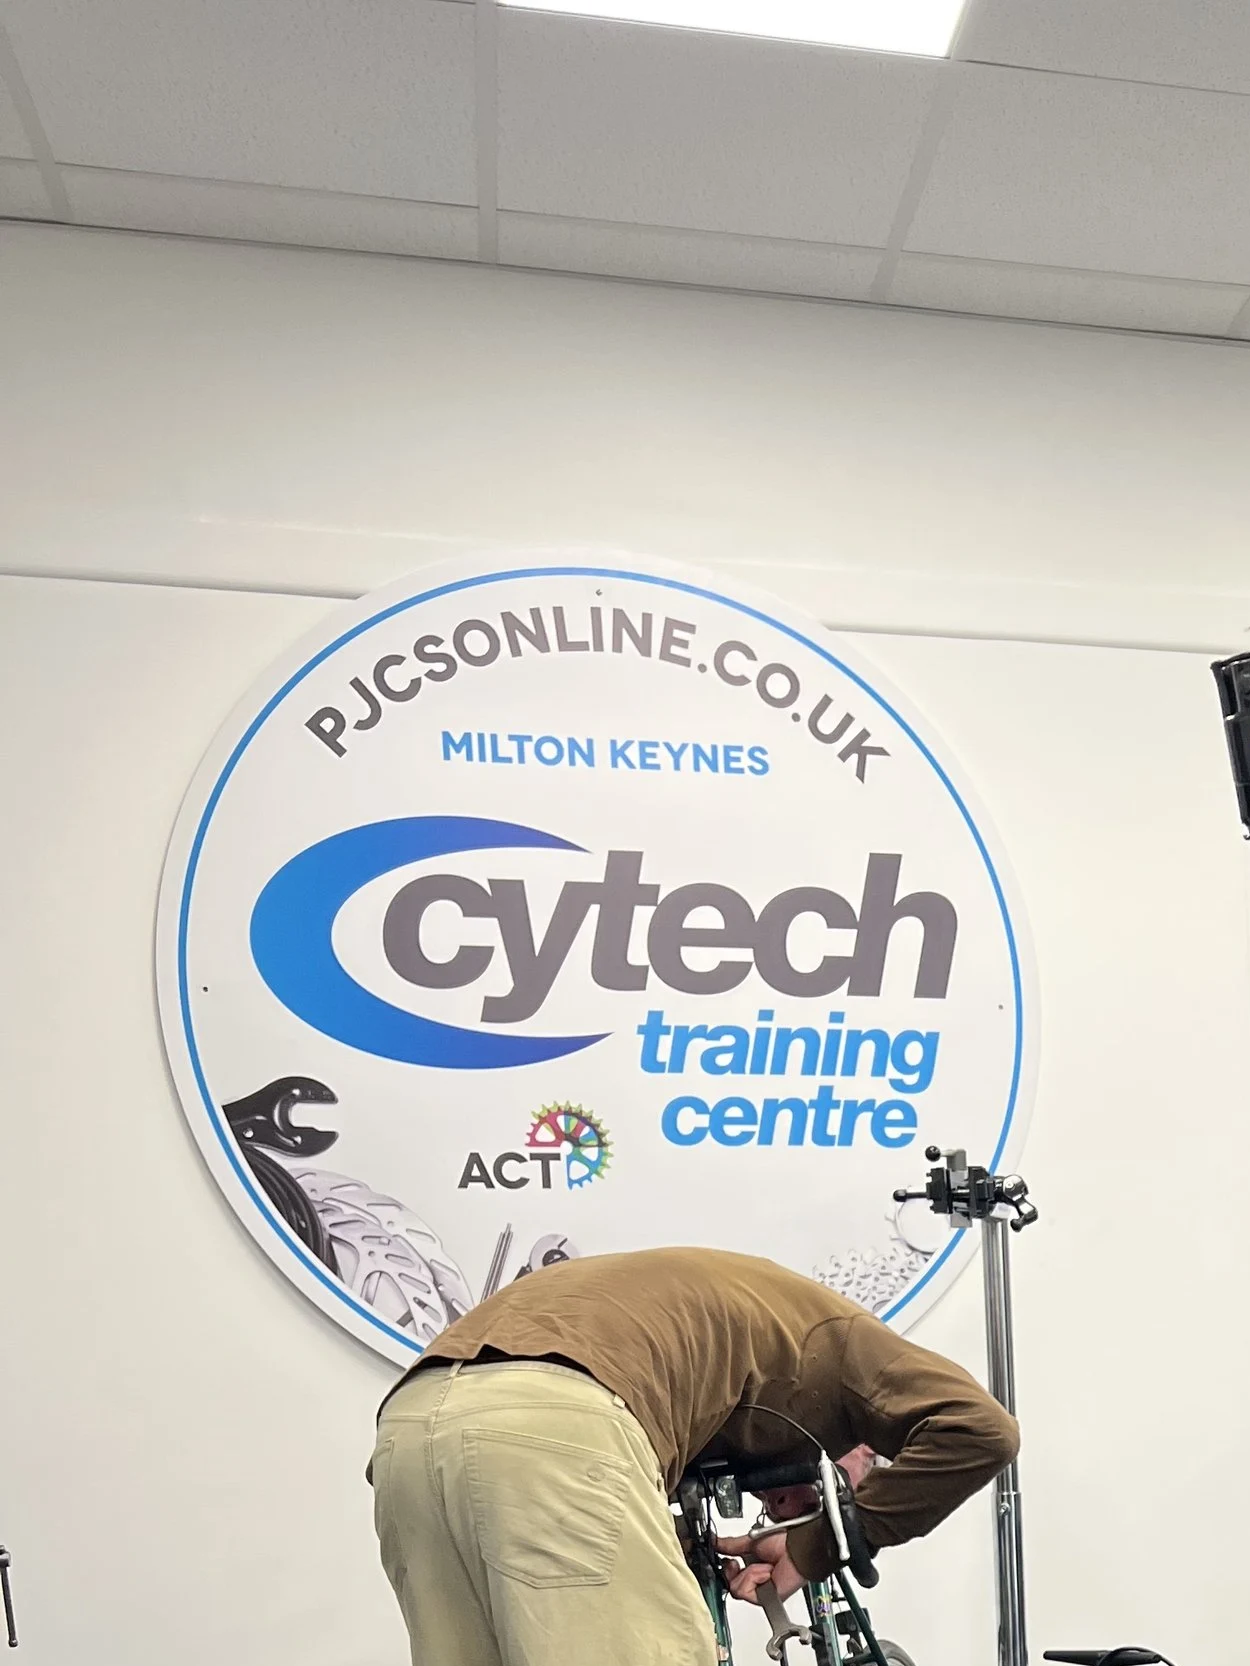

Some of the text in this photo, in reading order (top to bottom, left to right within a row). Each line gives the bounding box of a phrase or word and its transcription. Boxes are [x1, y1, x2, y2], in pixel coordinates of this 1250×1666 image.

[304, 605, 892, 784] PJCSONLINE.CO.UK
[441, 730, 771, 776] MILTON KEYNES
[382, 850, 959, 1023] cytech
[637, 1010, 940, 1091] training
[660, 1086, 918, 1148] centre
